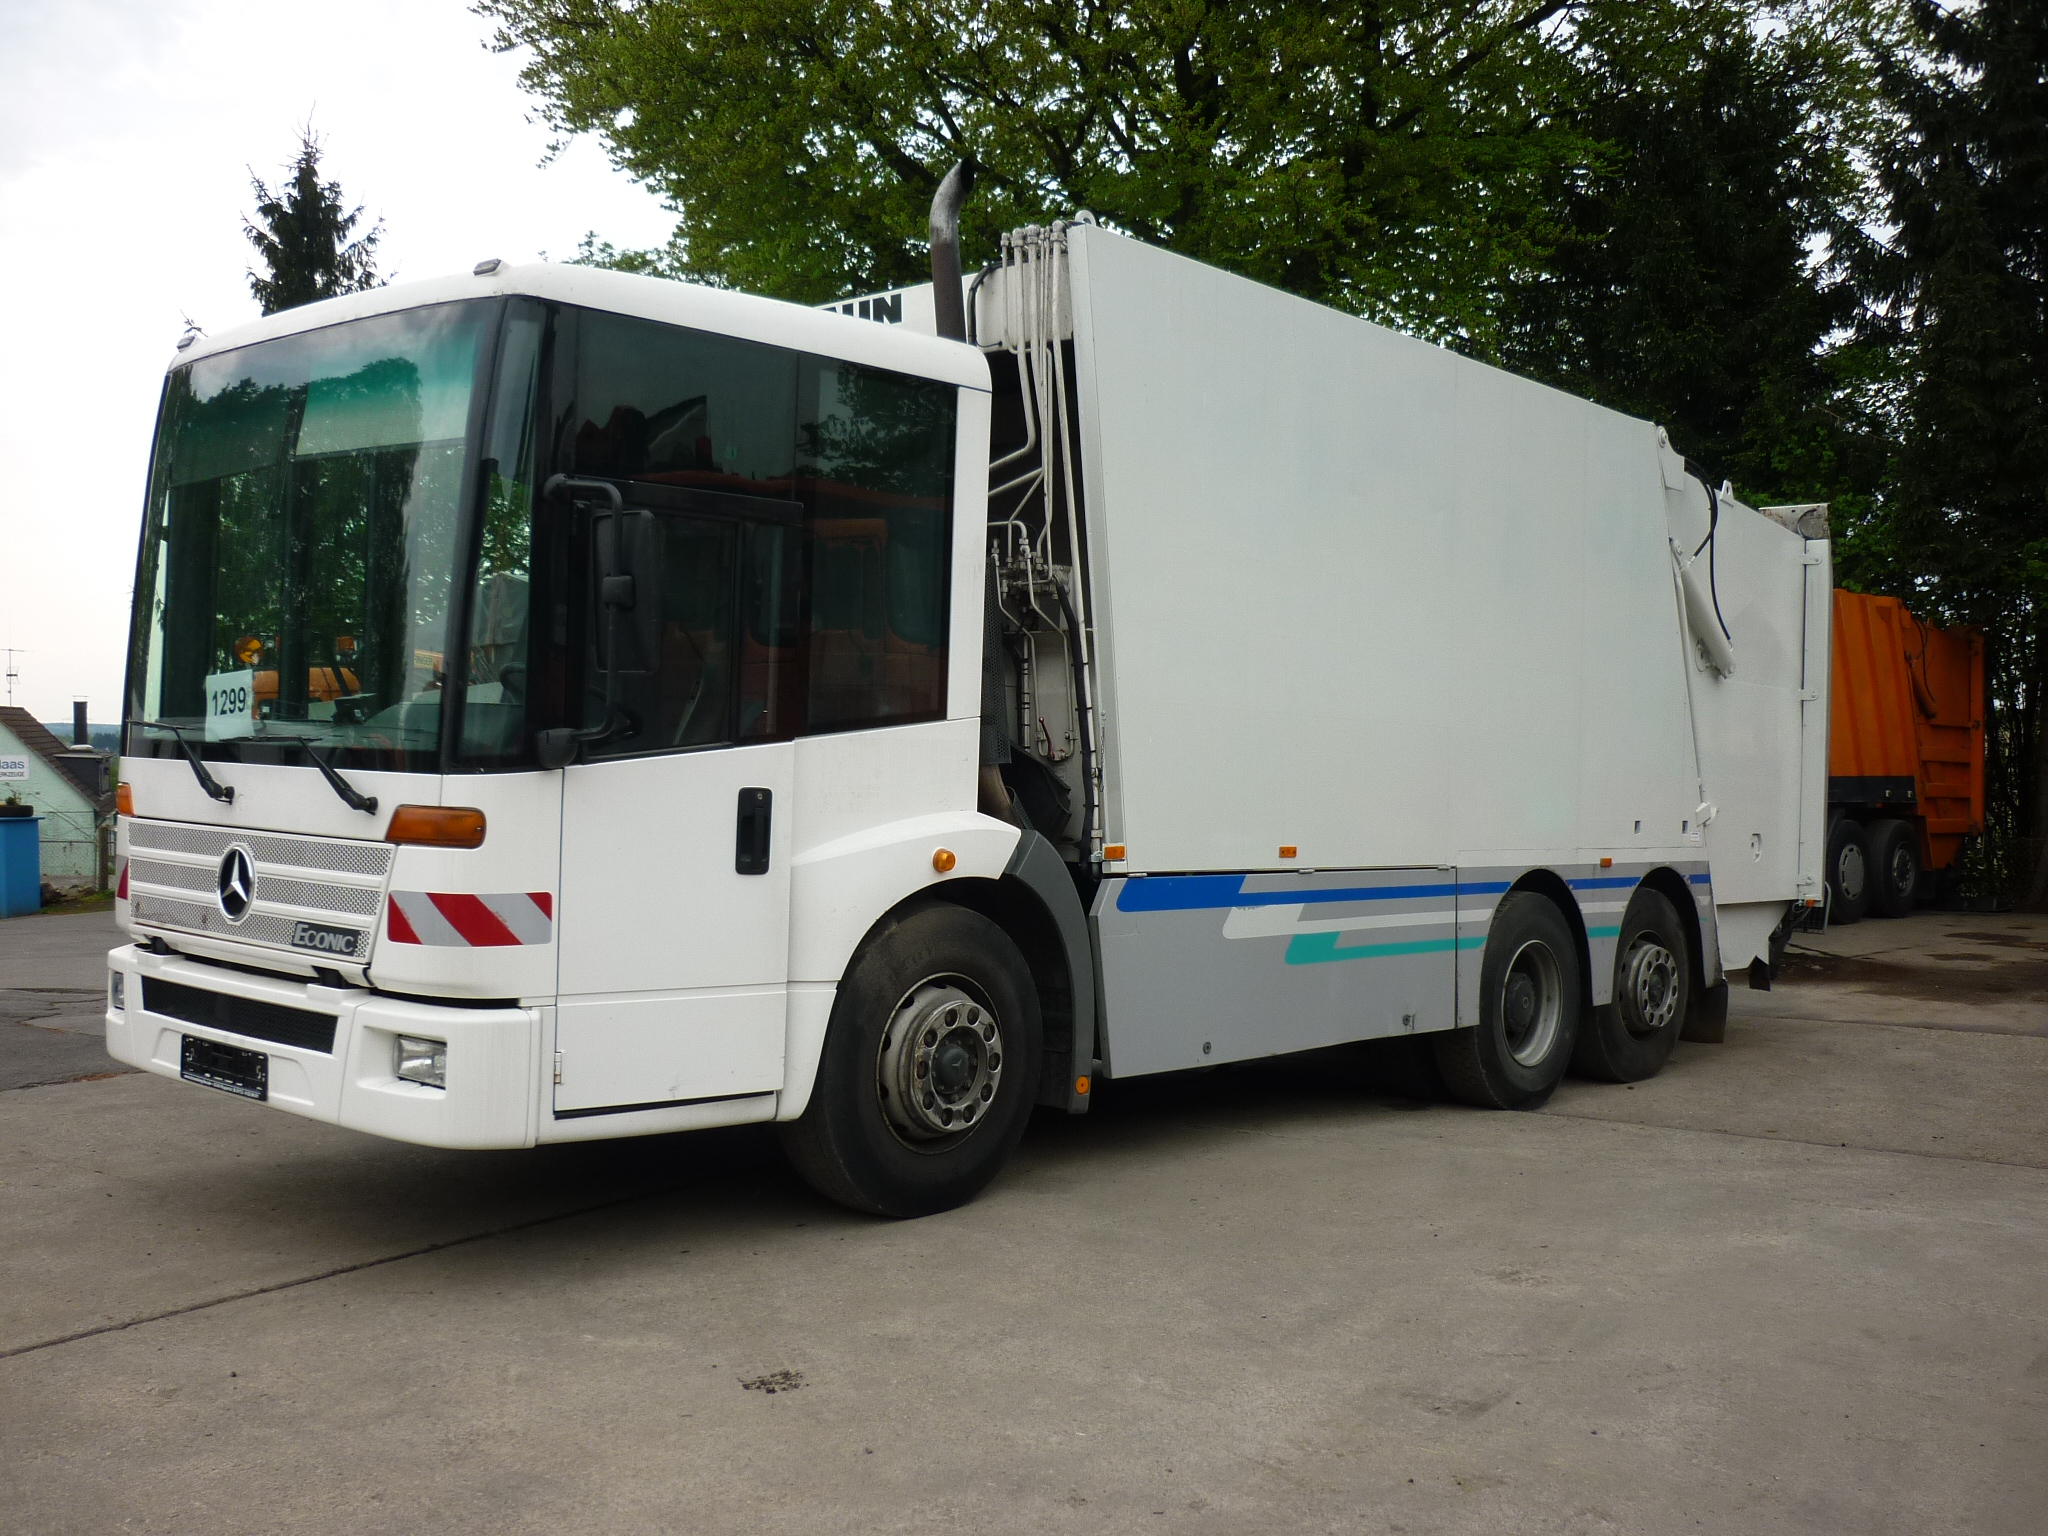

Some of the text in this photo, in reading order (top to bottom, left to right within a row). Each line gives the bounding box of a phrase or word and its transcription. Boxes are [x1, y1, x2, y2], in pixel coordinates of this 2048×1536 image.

[212, 687, 246, 716] 1299
[0, 759, 24, 770] aas
[293, 923, 354, 952] ECONIC
